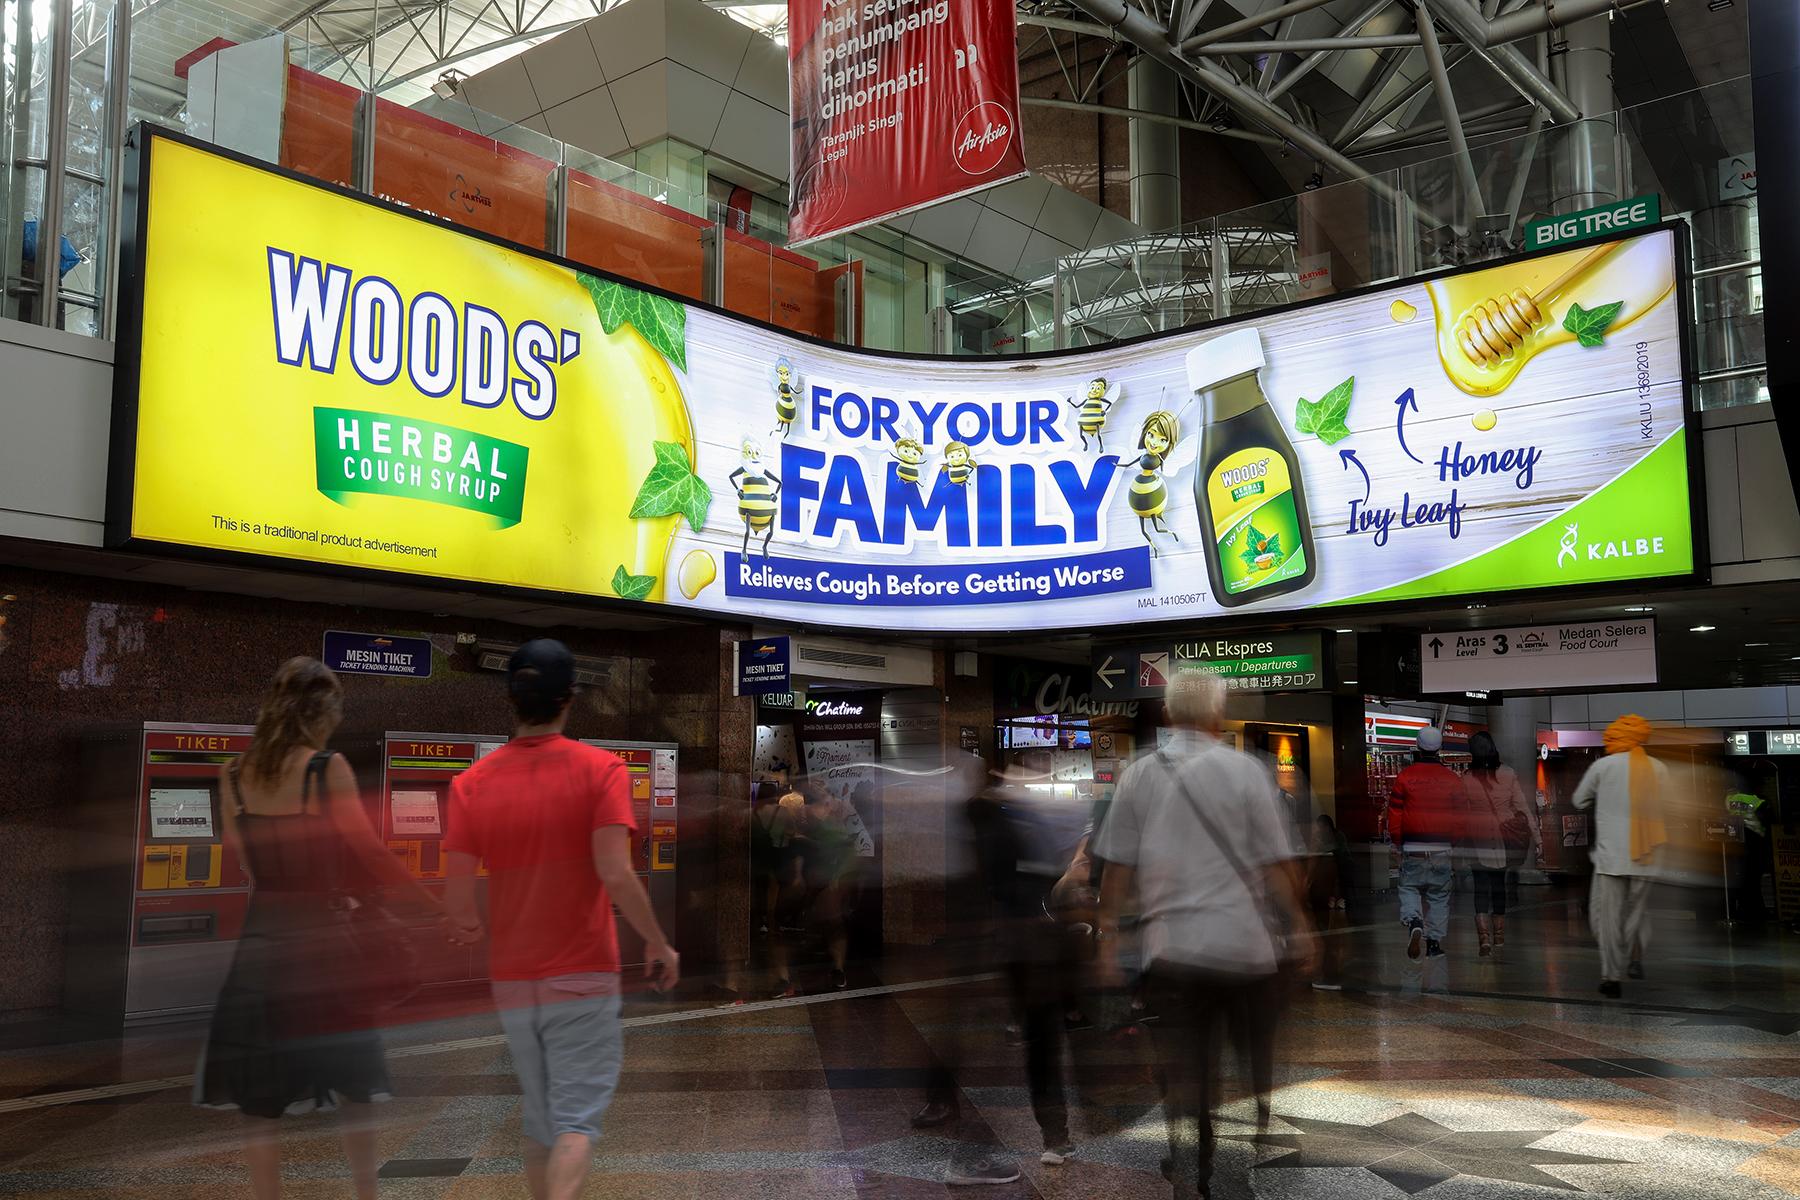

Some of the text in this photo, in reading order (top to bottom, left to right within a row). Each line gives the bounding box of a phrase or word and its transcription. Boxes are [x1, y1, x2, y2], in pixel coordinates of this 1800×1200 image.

[822, 8, 858, 39] hak
[822, 1, 949, 67] penumpang
[822, 57, 877, 93] harus
[821, 63, 929, 120] dihormati.
[821, 110, 903, 150] Taranjit Singh
[958, 123, 1009, 158] AirAsia
[821, 146, 848, 163] Legal
[1537, 203, 1646, 244] BIG TREE
[267, 246, 580, 421] WOODS'
[1636, 342, 1653, 439] KKLIU 1369/2019
[811, 385, 1065, 447] FOR YOUR
[337, 418, 508, 480] HERBAL
[1434, 441, 1543, 489] Honey
[344, 456, 501, 503] COUGH SYRUP
[780, 442, 1121, 548] FAMILY
[1346, 488, 1467, 547] Ivy Leaf
[212, 515, 437, 559] This is a traditional product advertisement
[1588, 537, 1665, 560] KALBE
[740, 563, 1125, 600] Relieves Cough Before Getting Worse
[1138, 592, 1207, 608] MAL 14105067T
[1456, 635, 1486, 648] Aras
[1492, 634, 1509, 655] 3
[1559, 624, 1647, 641] Medan Selera
[1560, 638, 1618, 650] Food Court
[346, 650, 413, 665] MESIN TIKET
[1174, 641, 1273, 659] KLIA Ekspres
[1456, 648, 1478, 657] Level
[340, 661, 416, 673] TICKET VENDING MACHINE
[745, 663, 785, 674] MESIN TIKET
[1241, 659, 1298, 673] Departures
[762, 693, 794, 706] KELUAR
[816, 701, 863, 716] Chatime
[176, 736, 230, 750] TIKET
[410, 744, 454, 756] TIKET
